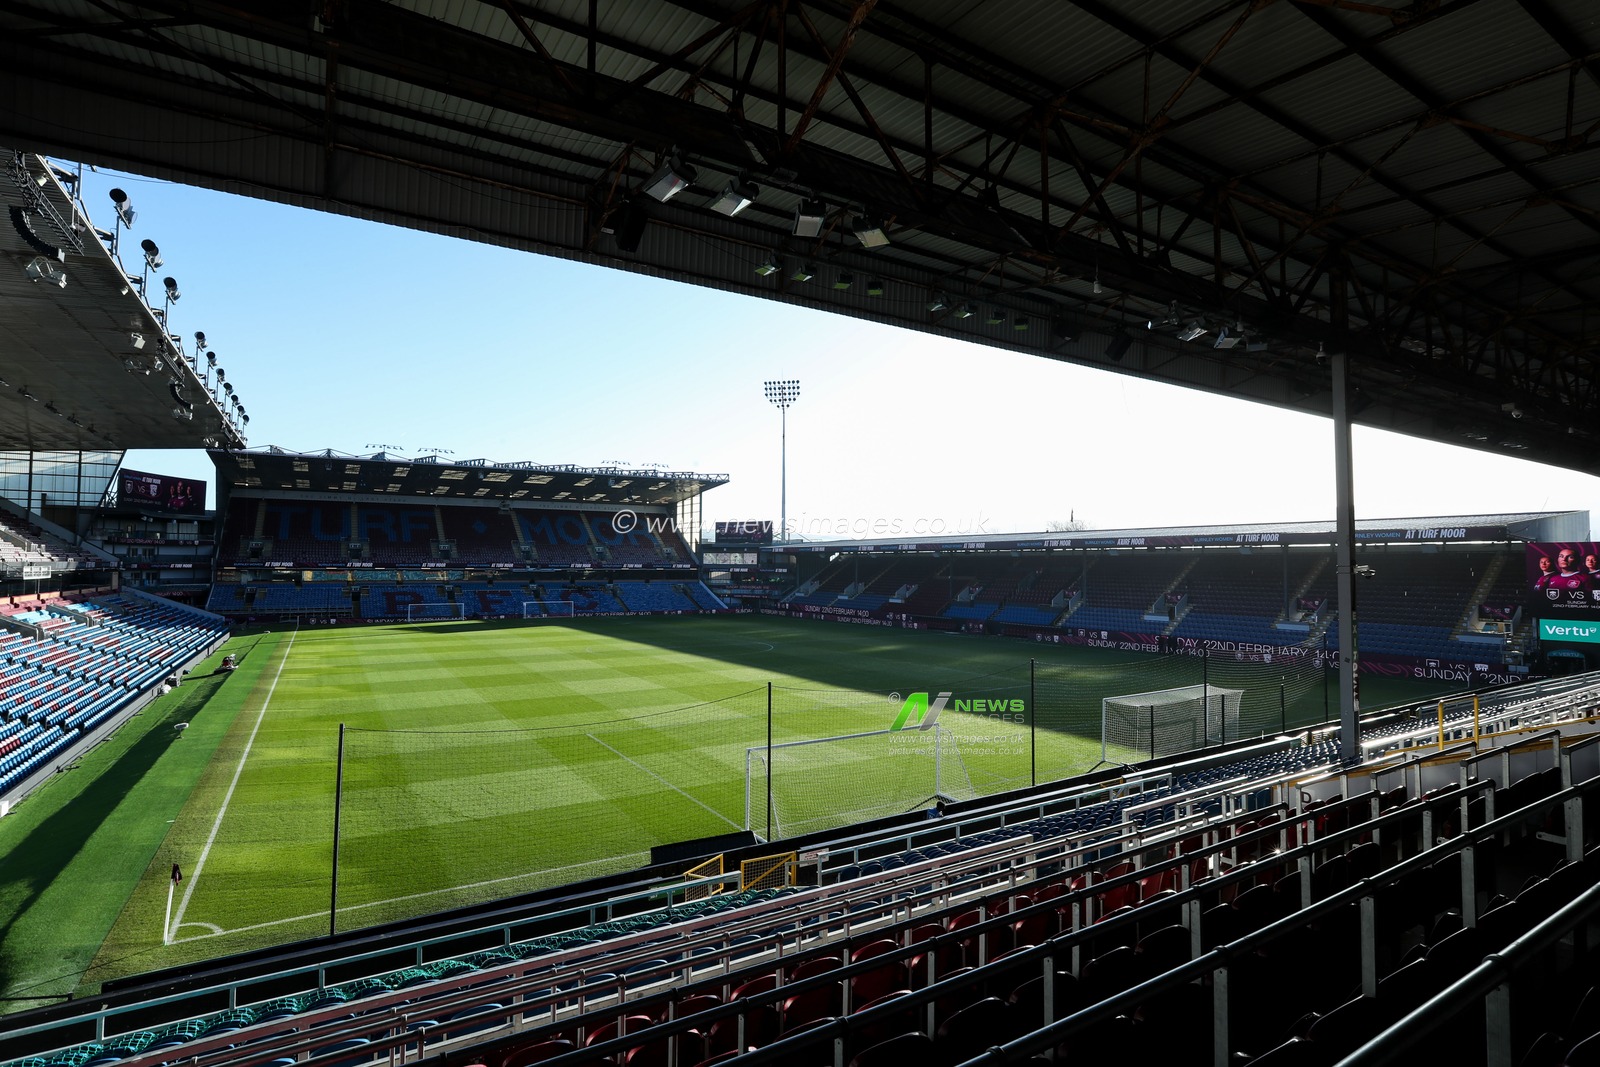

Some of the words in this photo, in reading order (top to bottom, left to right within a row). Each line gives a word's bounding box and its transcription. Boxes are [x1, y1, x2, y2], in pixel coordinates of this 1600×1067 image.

[266, 506, 436, 542] TURF
[1236, 534, 1244, 543] AT
[1245, 534, 1260, 542] TURF
[1260, 533, 1280, 542] MOOR
[1405, 529, 1414, 539] AT
[1418, 529, 1439, 539] TURF
[1440, 528, 1466, 538] MOOR
[1568, 590, 1585, 600] VS
[804, 604, 821, 612] SUNDAY
[833, 607, 856, 616] FEBRUARY
[1545, 624, 1589, 637] Vertu
[1087, 638, 1117, 649] SUNDAY
[1119, 642, 1141, 651] 22ND
[1154, 636, 1199, 648] SDAY
[1203, 639, 1236, 651] 22ND
[1249, 654, 1259, 662] VS
[1329, 660, 1340, 669] VS
[1414, 667, 1472, 682] SUNDAY
